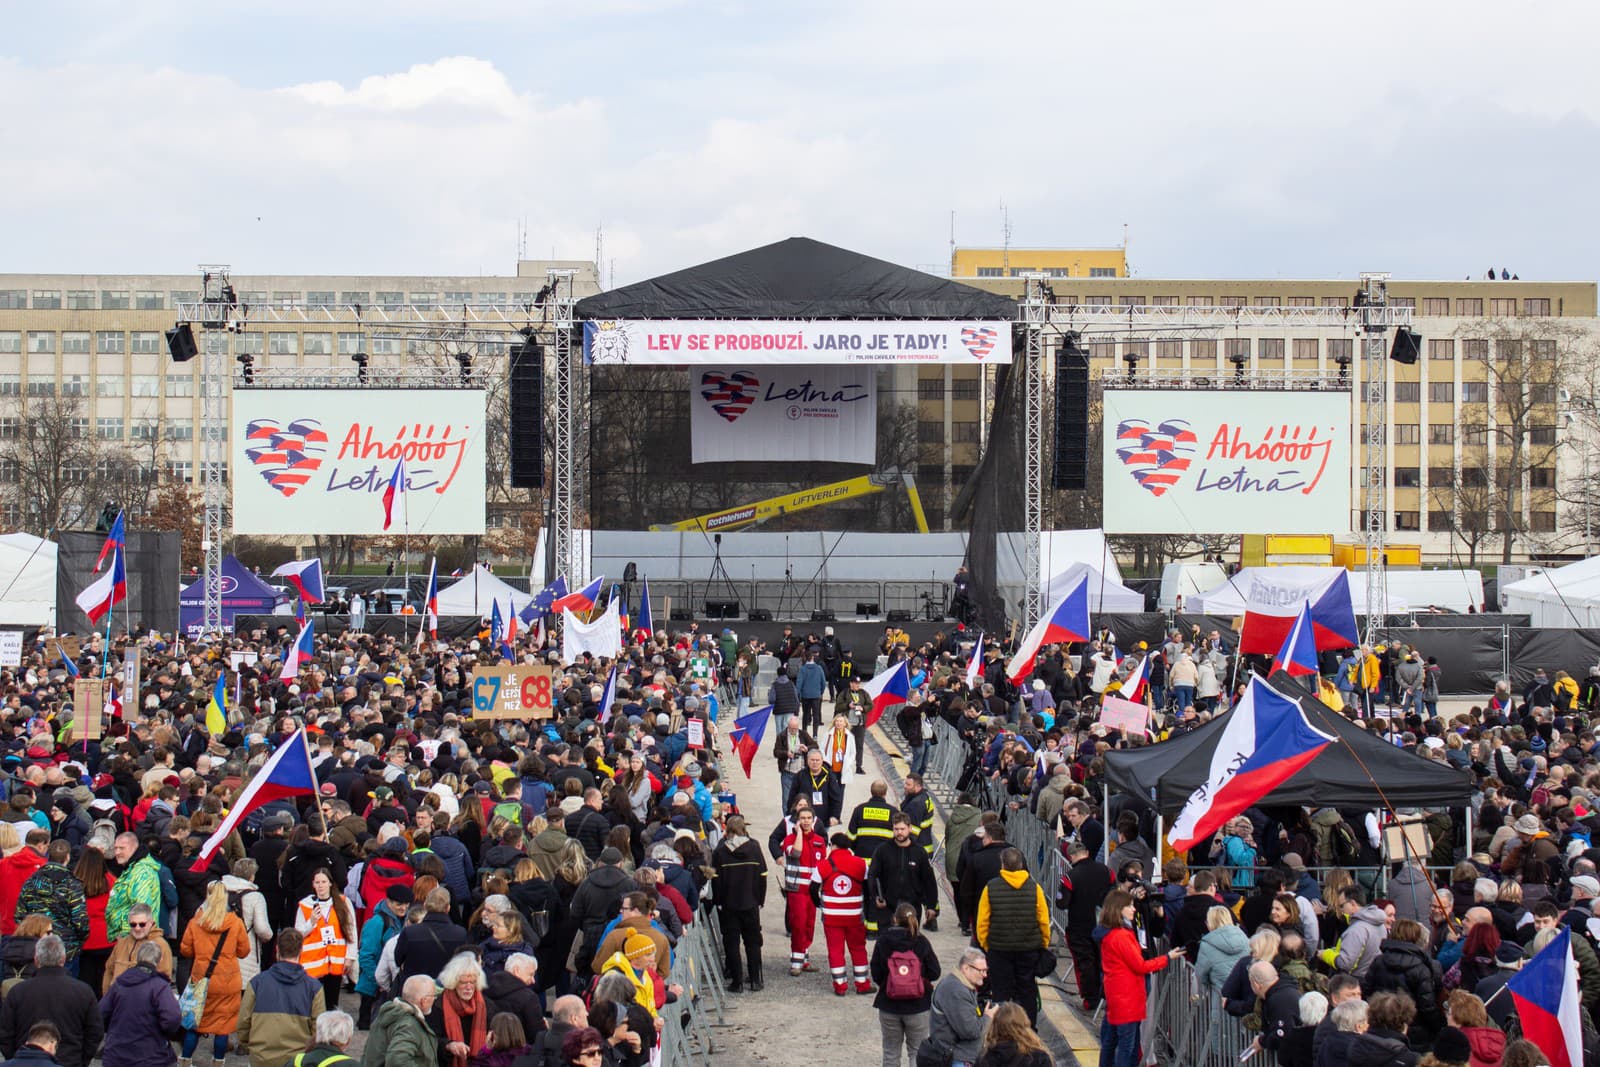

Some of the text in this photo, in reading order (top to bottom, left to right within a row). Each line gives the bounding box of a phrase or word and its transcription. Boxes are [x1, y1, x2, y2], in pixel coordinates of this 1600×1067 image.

[647, 330, 948, 351] LEV SE PROBOUZÍ. JARO JE TADY!
[763, 379, 869, 403] Letná
[1195, 466, 1305, 493] Letná
[793, 485, 849, 506] LIFTVERLEIH
[707, 508, 755, 529] Rothlehner
[504, 673, 517, 686] JE
[473, 676, 501, 711] 67
[521, 675, 552, 709] 68.
